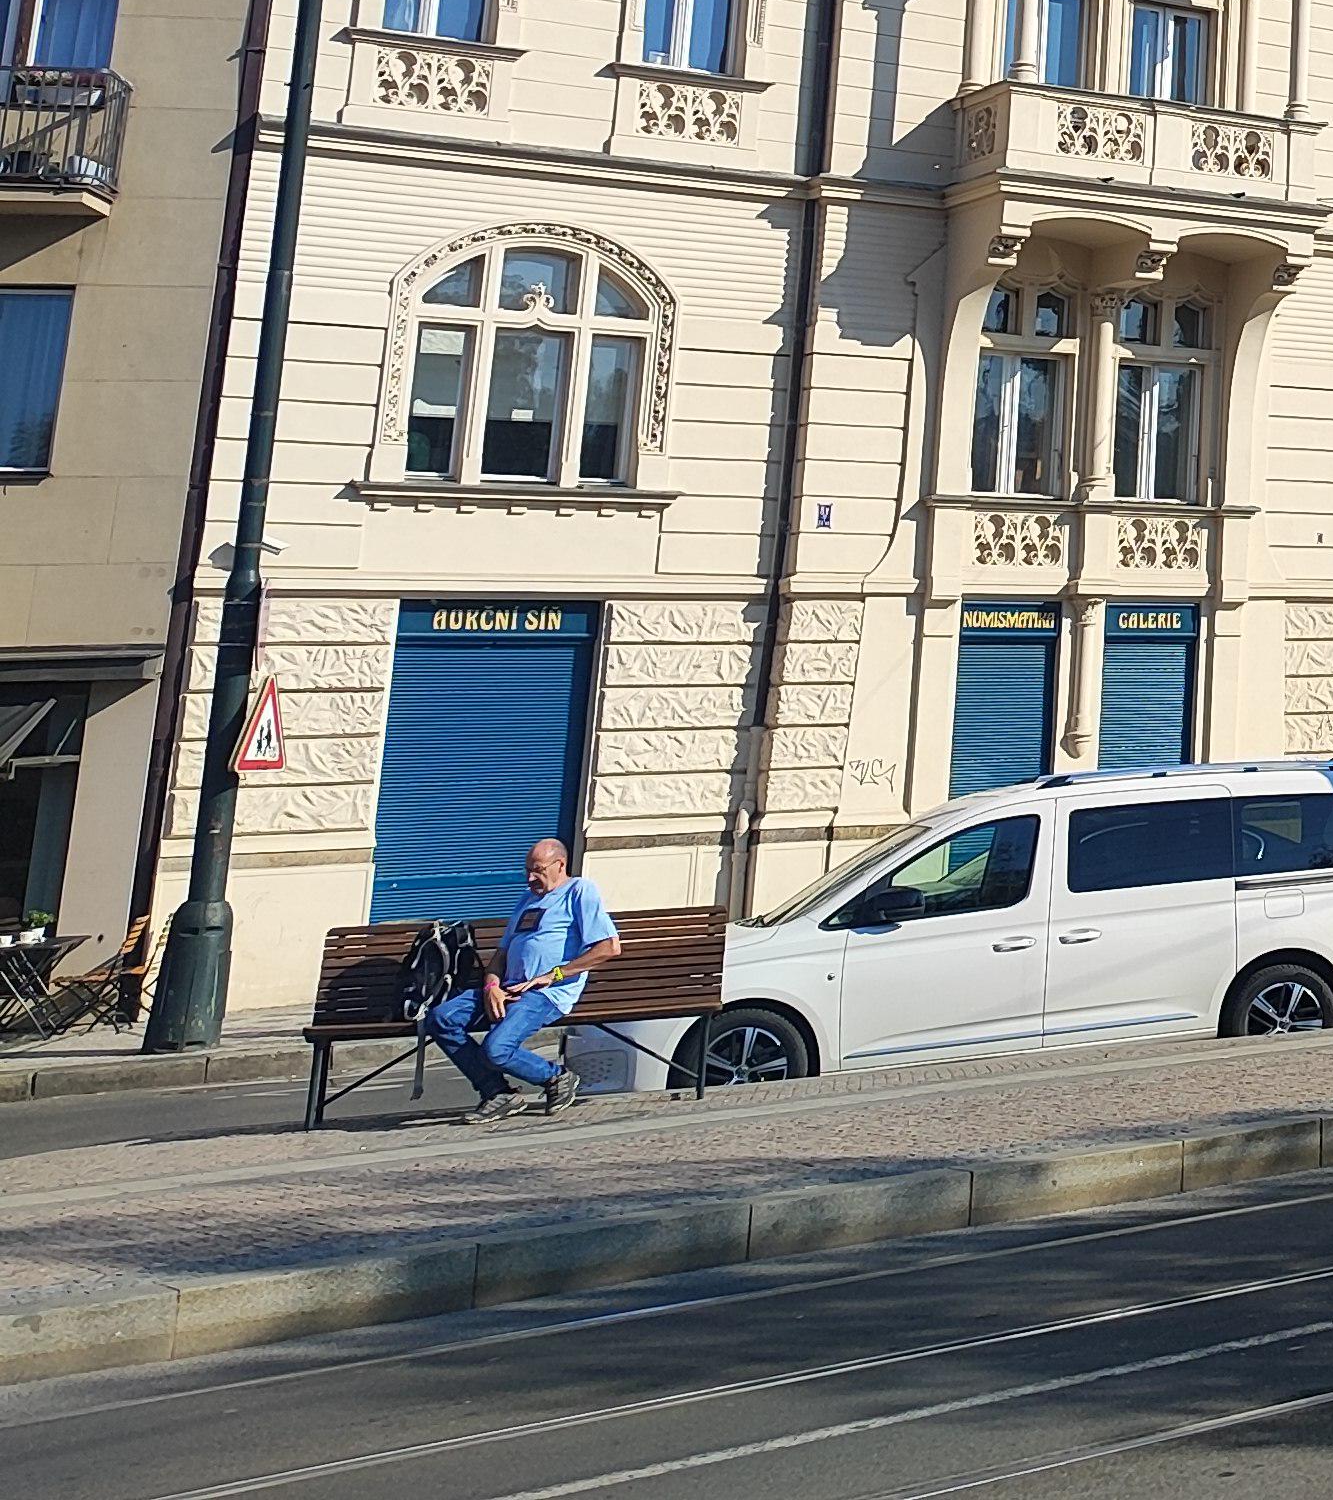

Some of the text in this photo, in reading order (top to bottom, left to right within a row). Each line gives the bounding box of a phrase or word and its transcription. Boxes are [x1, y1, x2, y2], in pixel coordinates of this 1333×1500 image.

[432, 605, 562, 631] AUKČNÍ SÍŇ
[962, 609, 1056, 630] NUMISMATIKA
[1118, 611, 1182, 630] GALERIE
